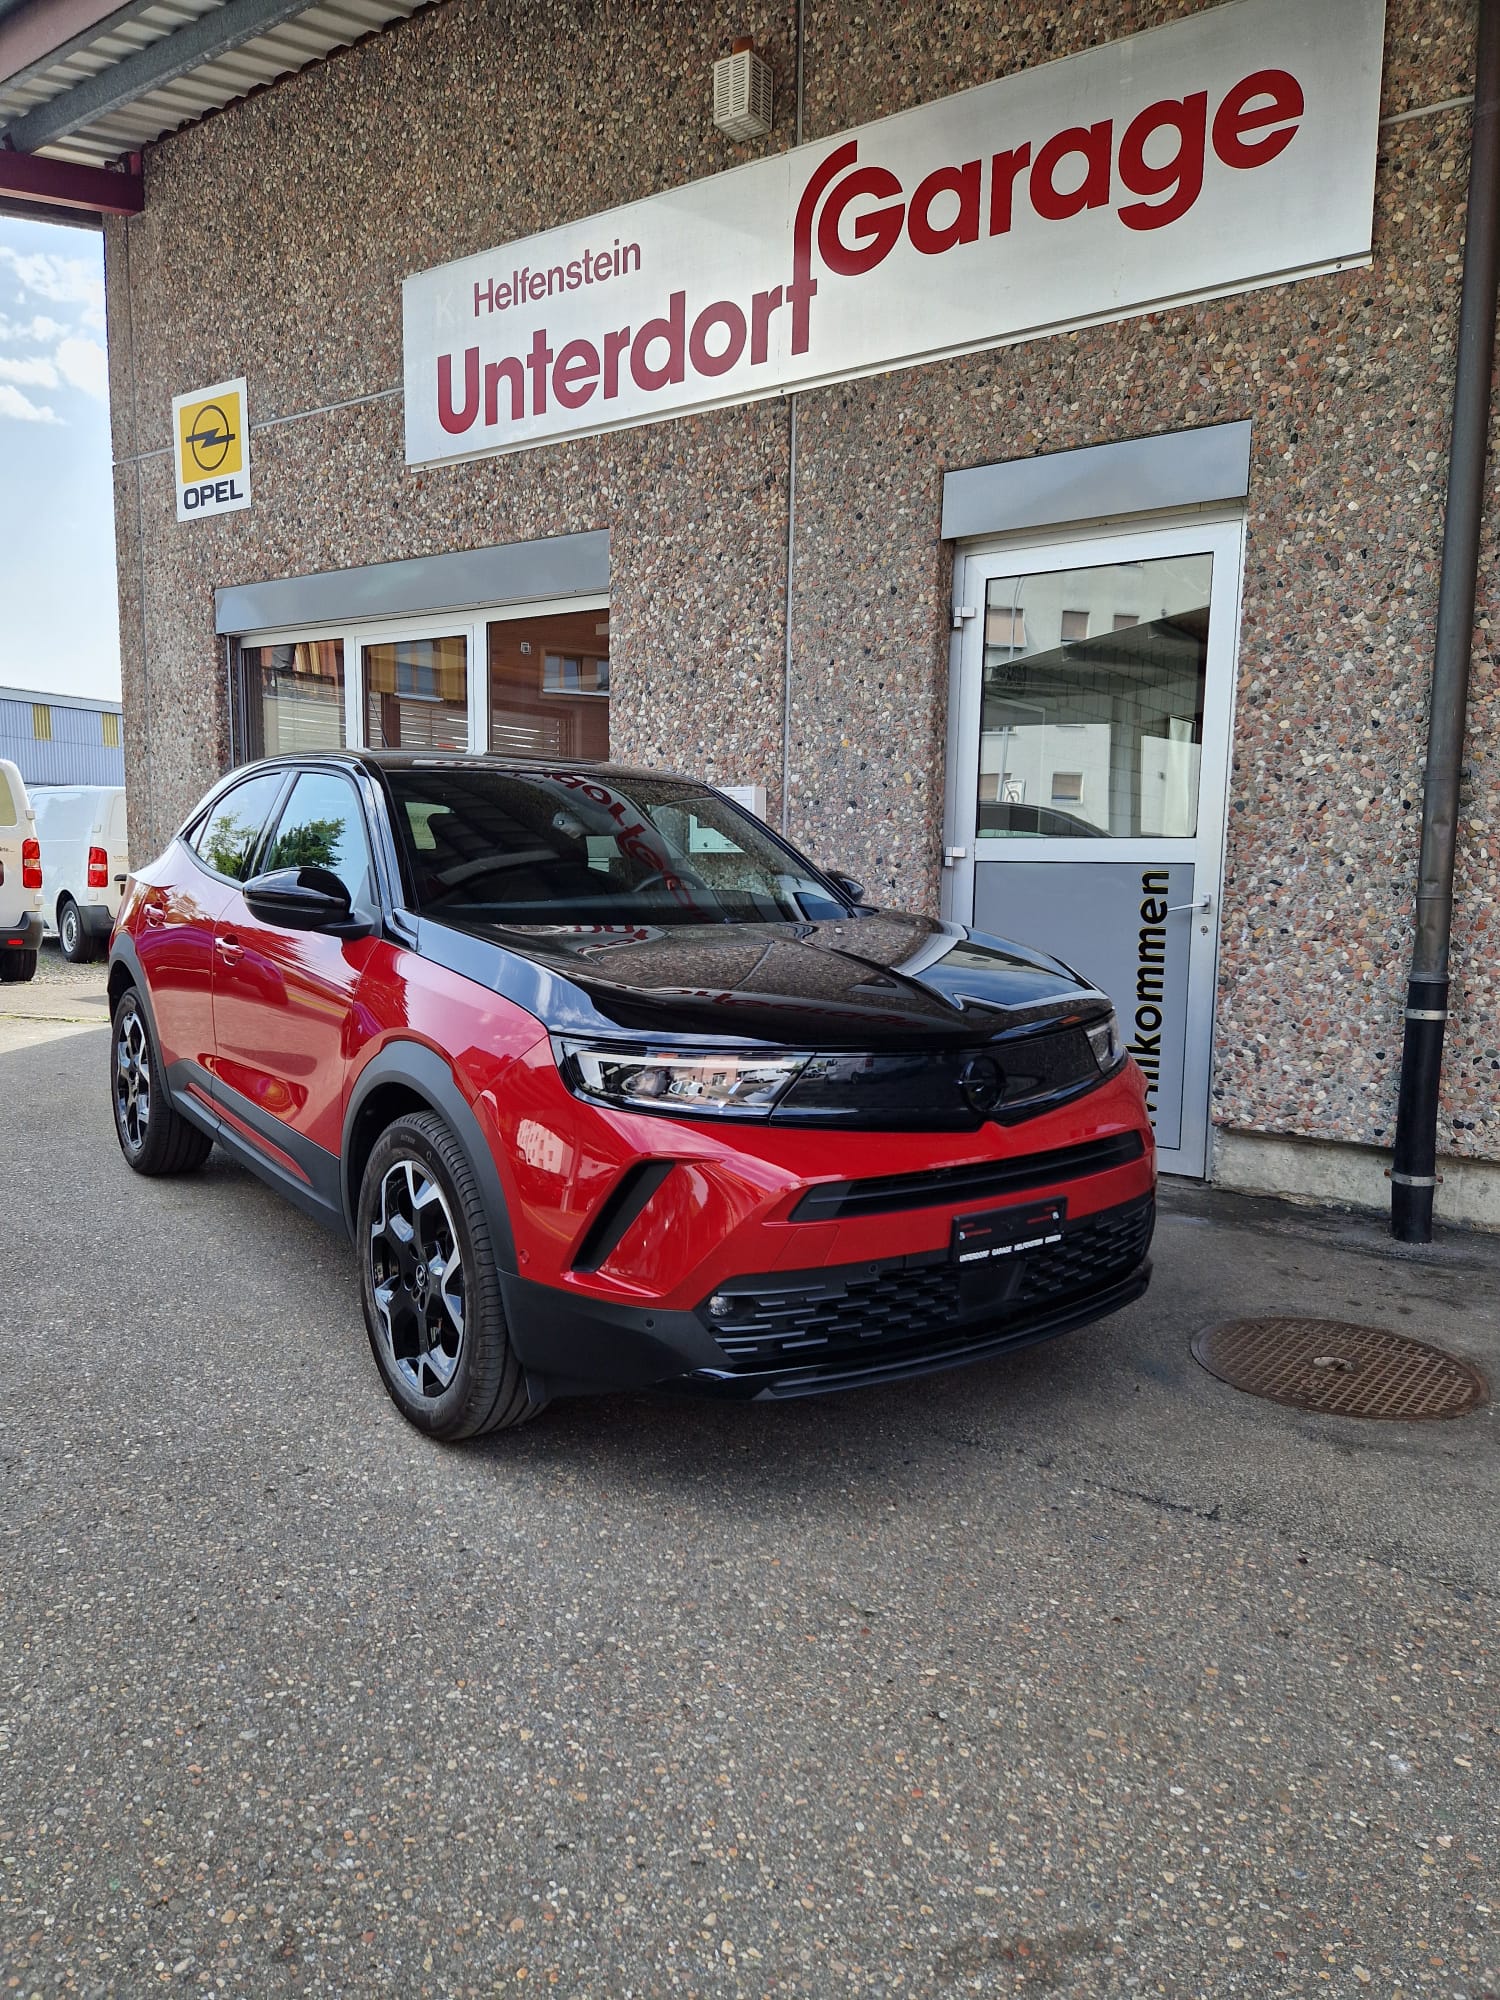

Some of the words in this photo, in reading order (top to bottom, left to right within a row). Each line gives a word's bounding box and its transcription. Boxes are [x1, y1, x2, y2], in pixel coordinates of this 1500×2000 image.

[437, 139, 858, 435] Unterdorf
[817, 69, 1305, 276] Garage
[473, 238, 641, 317] Helfenstein
[183, 479, 244, 510] OPEL
[1123, 870, 1170, 1127] lkommen
